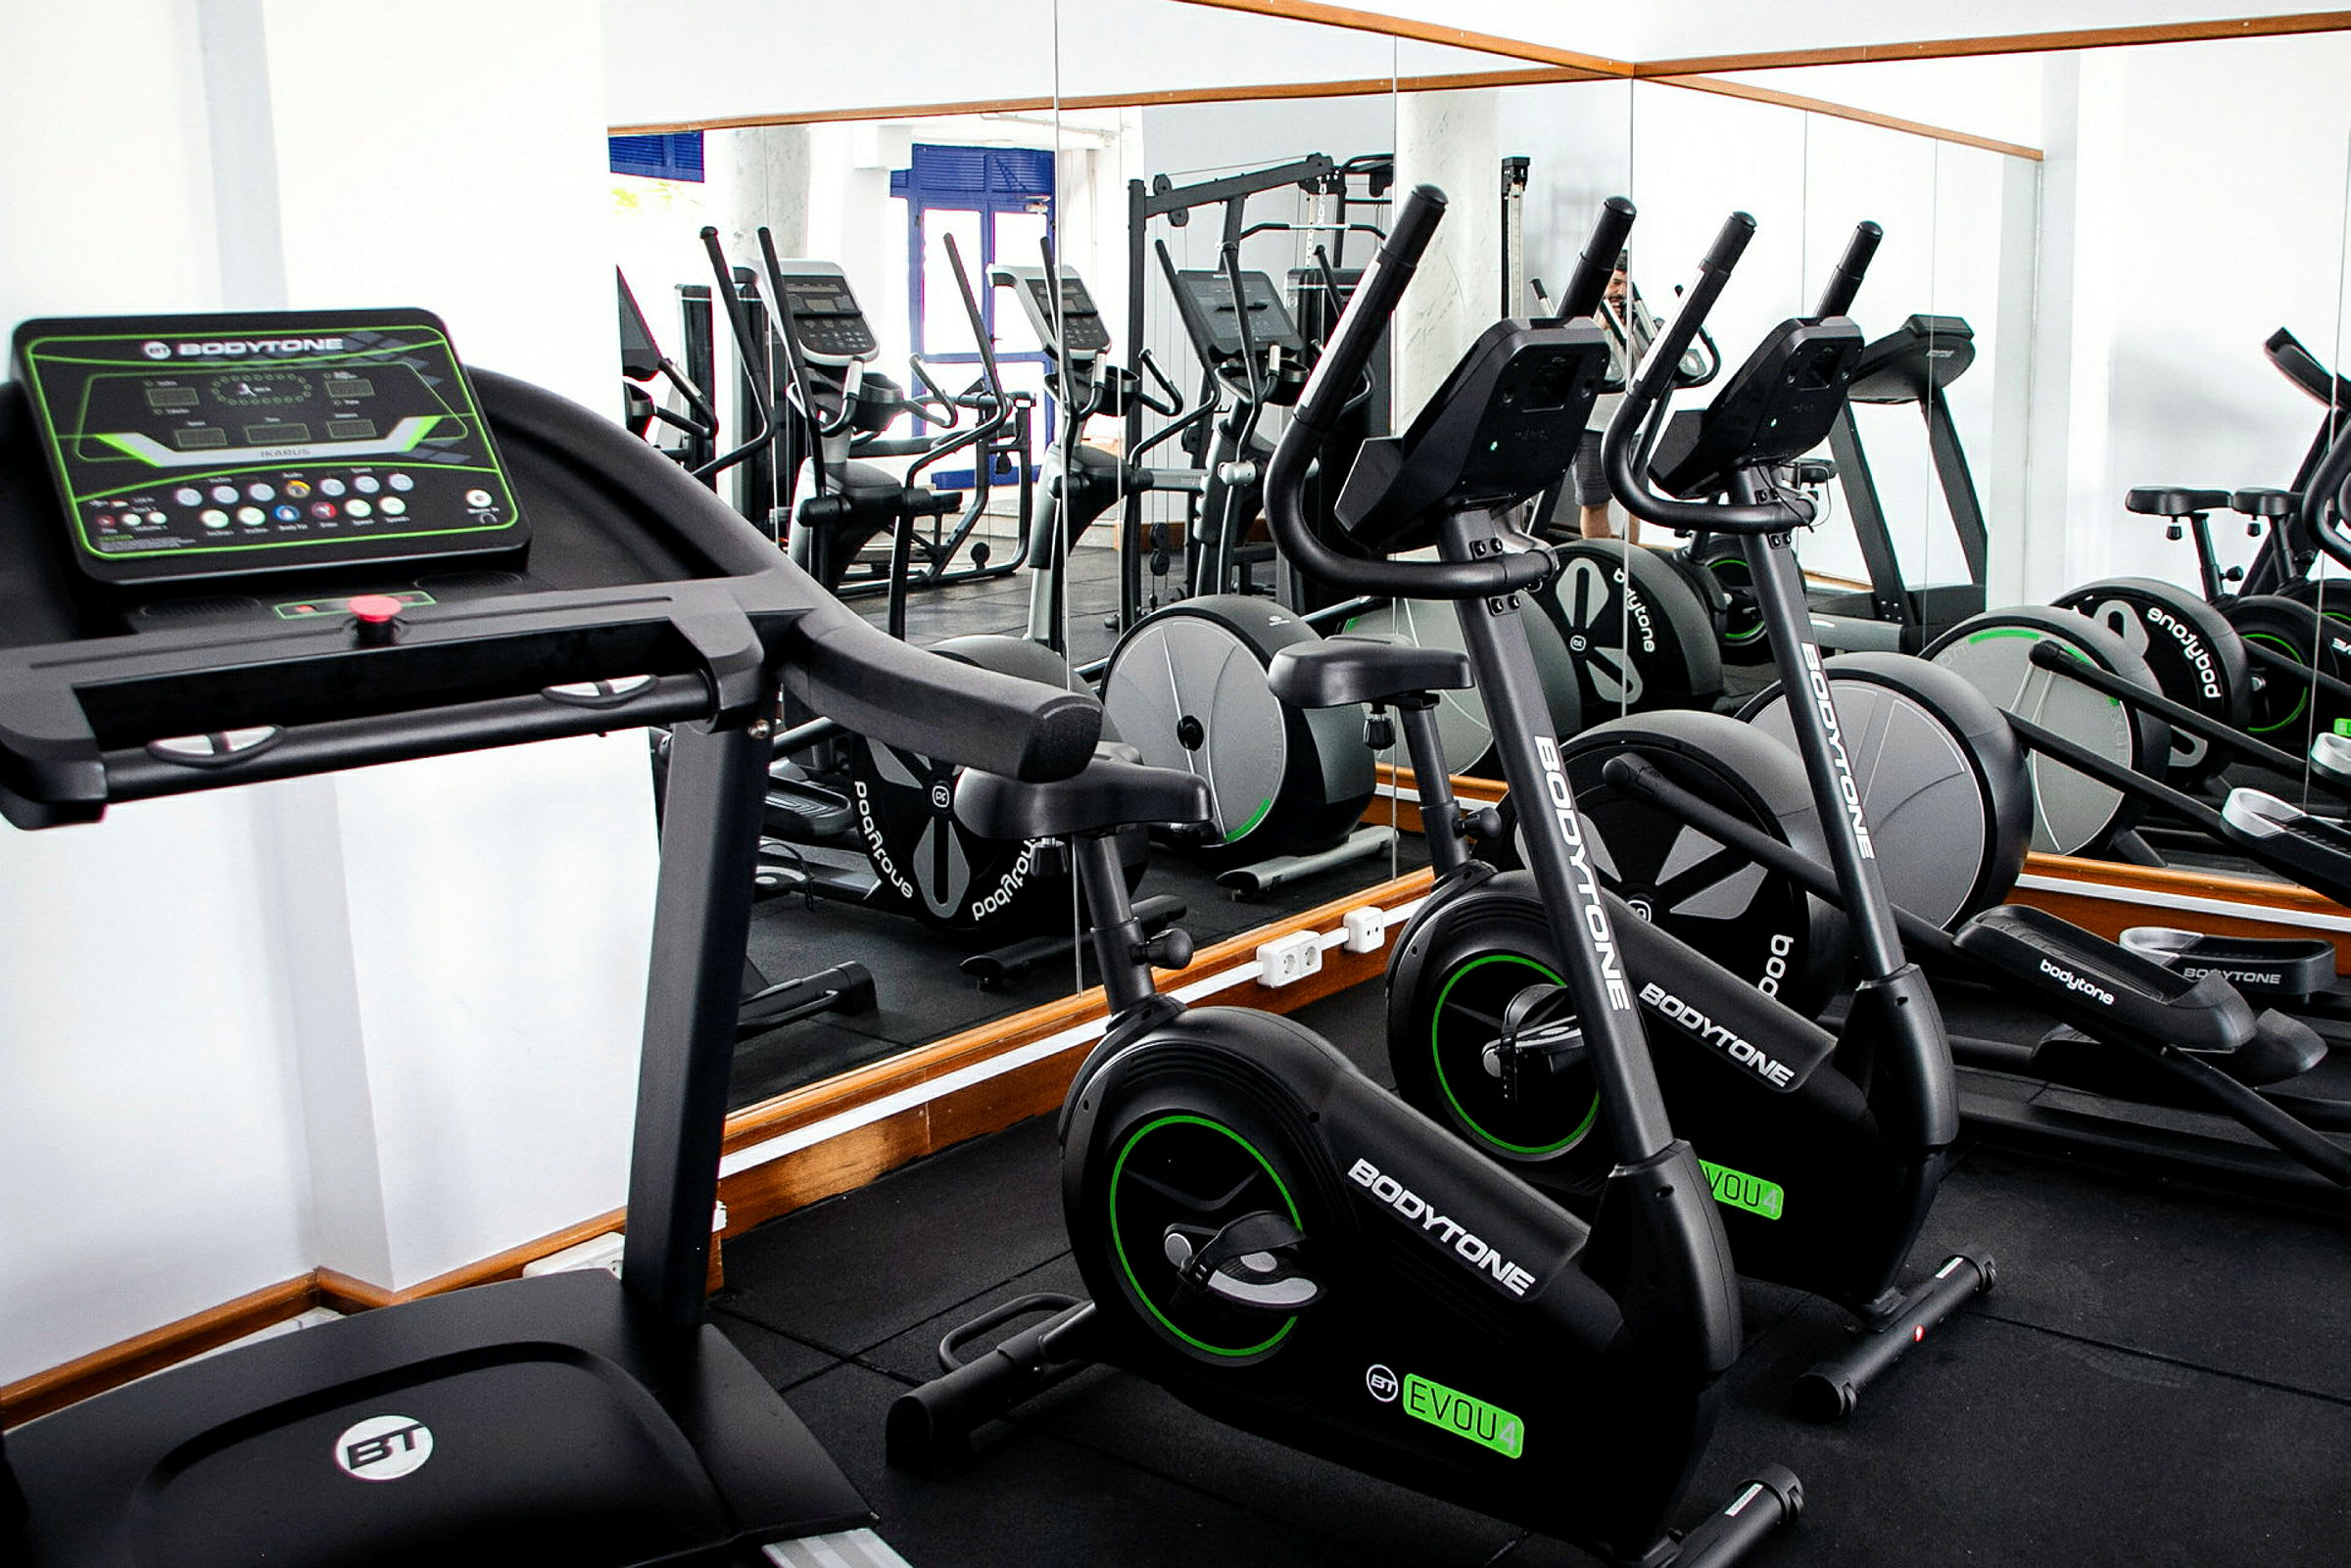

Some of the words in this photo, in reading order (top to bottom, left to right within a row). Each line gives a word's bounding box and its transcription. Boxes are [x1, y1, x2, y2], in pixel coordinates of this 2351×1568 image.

[178, 338, 344, 356] BODYTONE
[261, 448, 311, 457] IKARUS
[1613, 567, 1655, 653] bdytone
[1800, 641, 1876, 860] BODYTONE
[1534, 736, 1630, 1011] BODYTONE
[2039, 959, 2114, 1006] bodytone
[2183, 967, 2281, 985] BOYTONE
[1639, 982, 1795, 1087] BODYTONE
[1705, 1165, 1778, 1215] VOU4
[1347, 1158, 1536, 1297] BODYTONE
[1371, 1373, 1397, 1393] BT
[1410, 1381, 1515, 1451] EVOU4
[347, 1422, 425, 1471] BT
